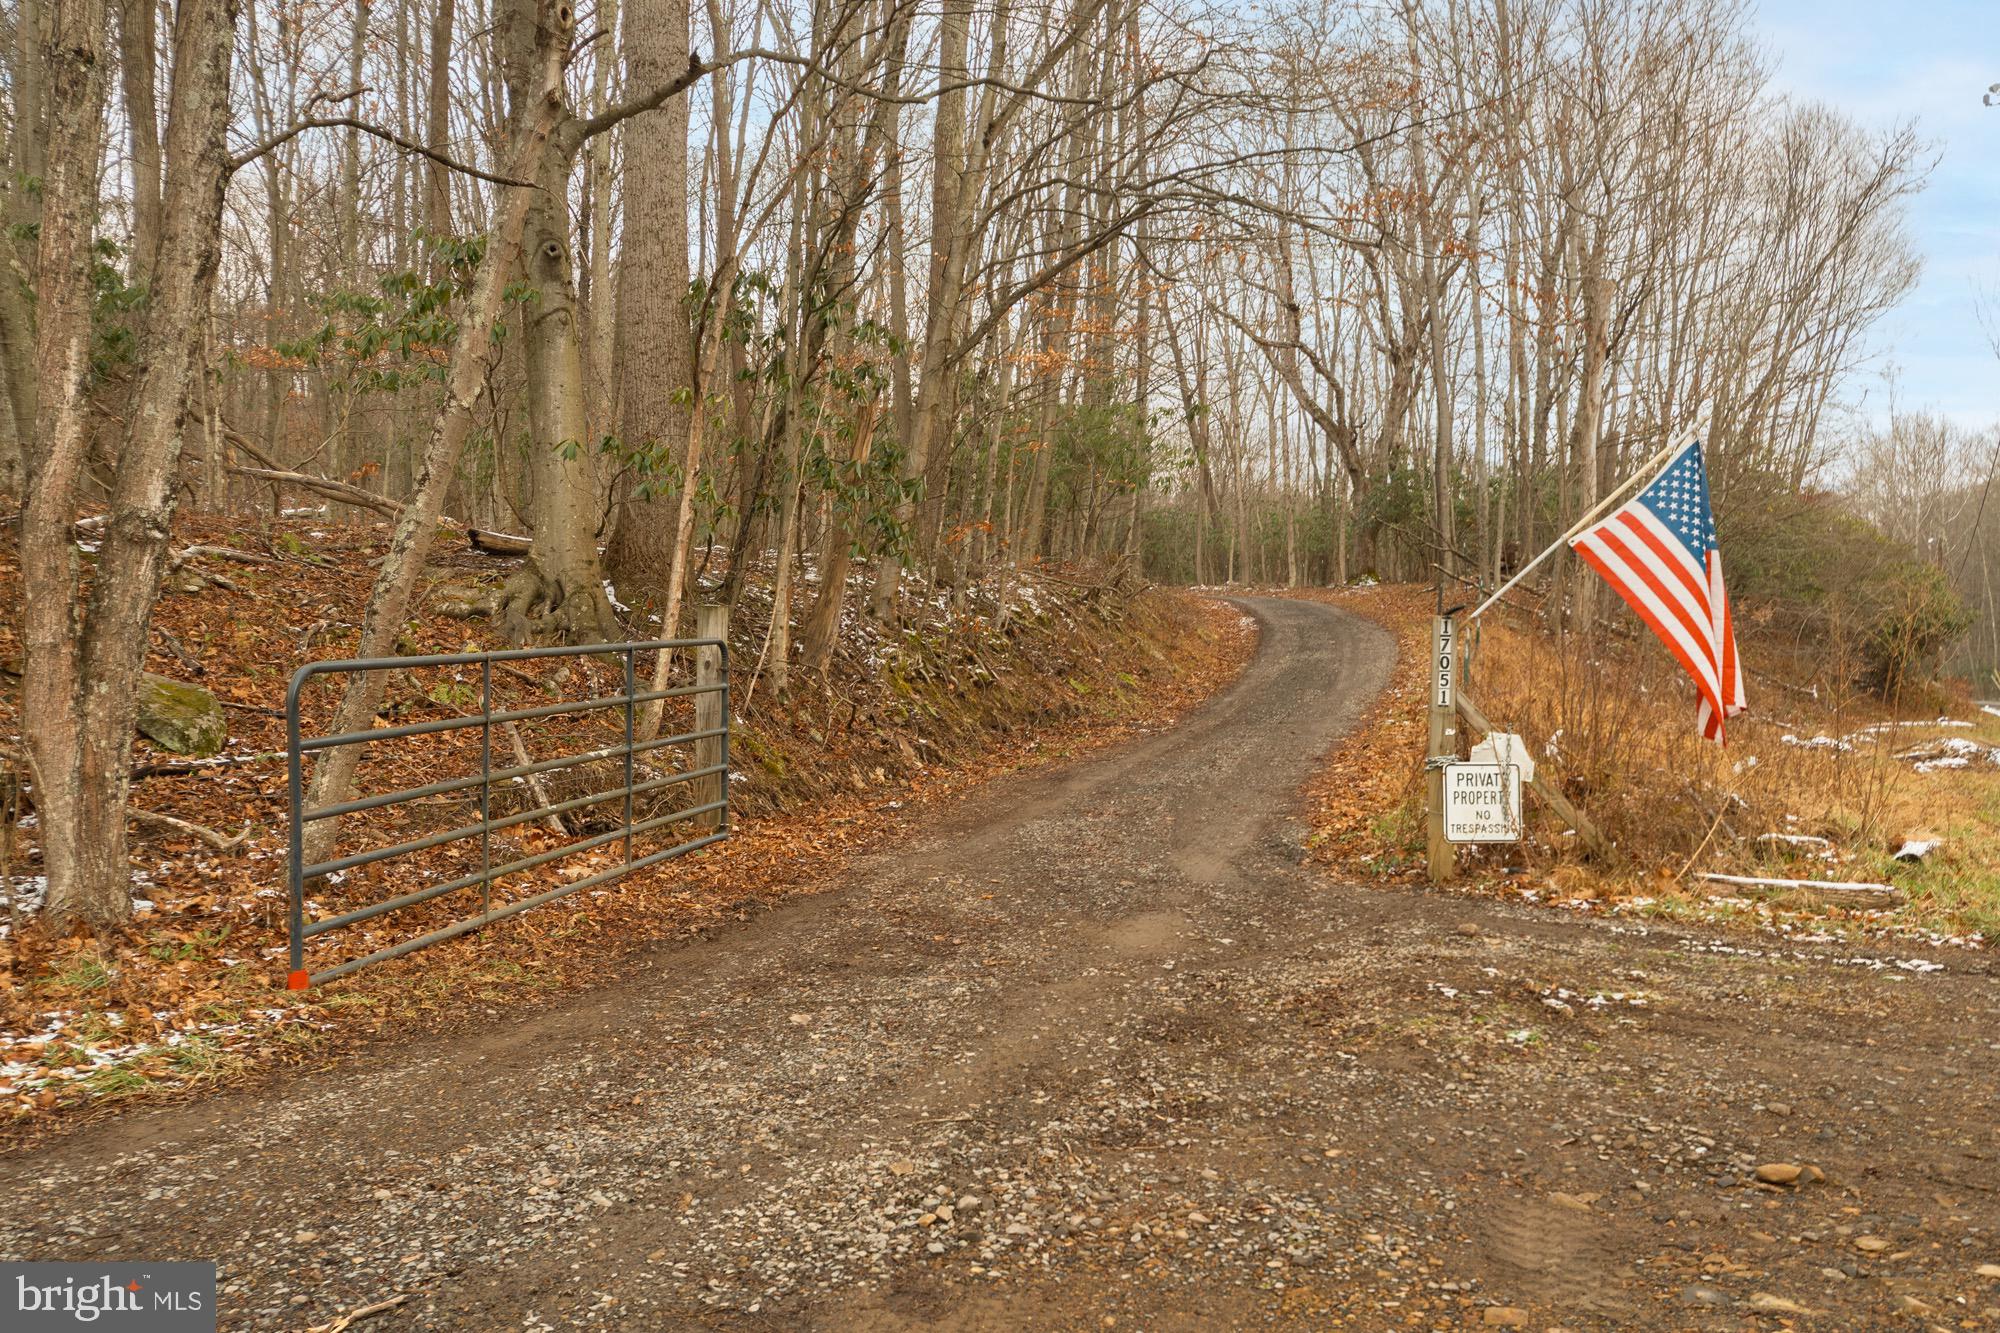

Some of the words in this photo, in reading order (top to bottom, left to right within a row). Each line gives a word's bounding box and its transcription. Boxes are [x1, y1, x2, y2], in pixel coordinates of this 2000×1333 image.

[1439, 620, 1450, 704] 17051
[1456, 772, 1507, 787] PRIVAT
[1453, 790, 1511, 805] PROPERT
[1475, 810, 1491, 820] NO
